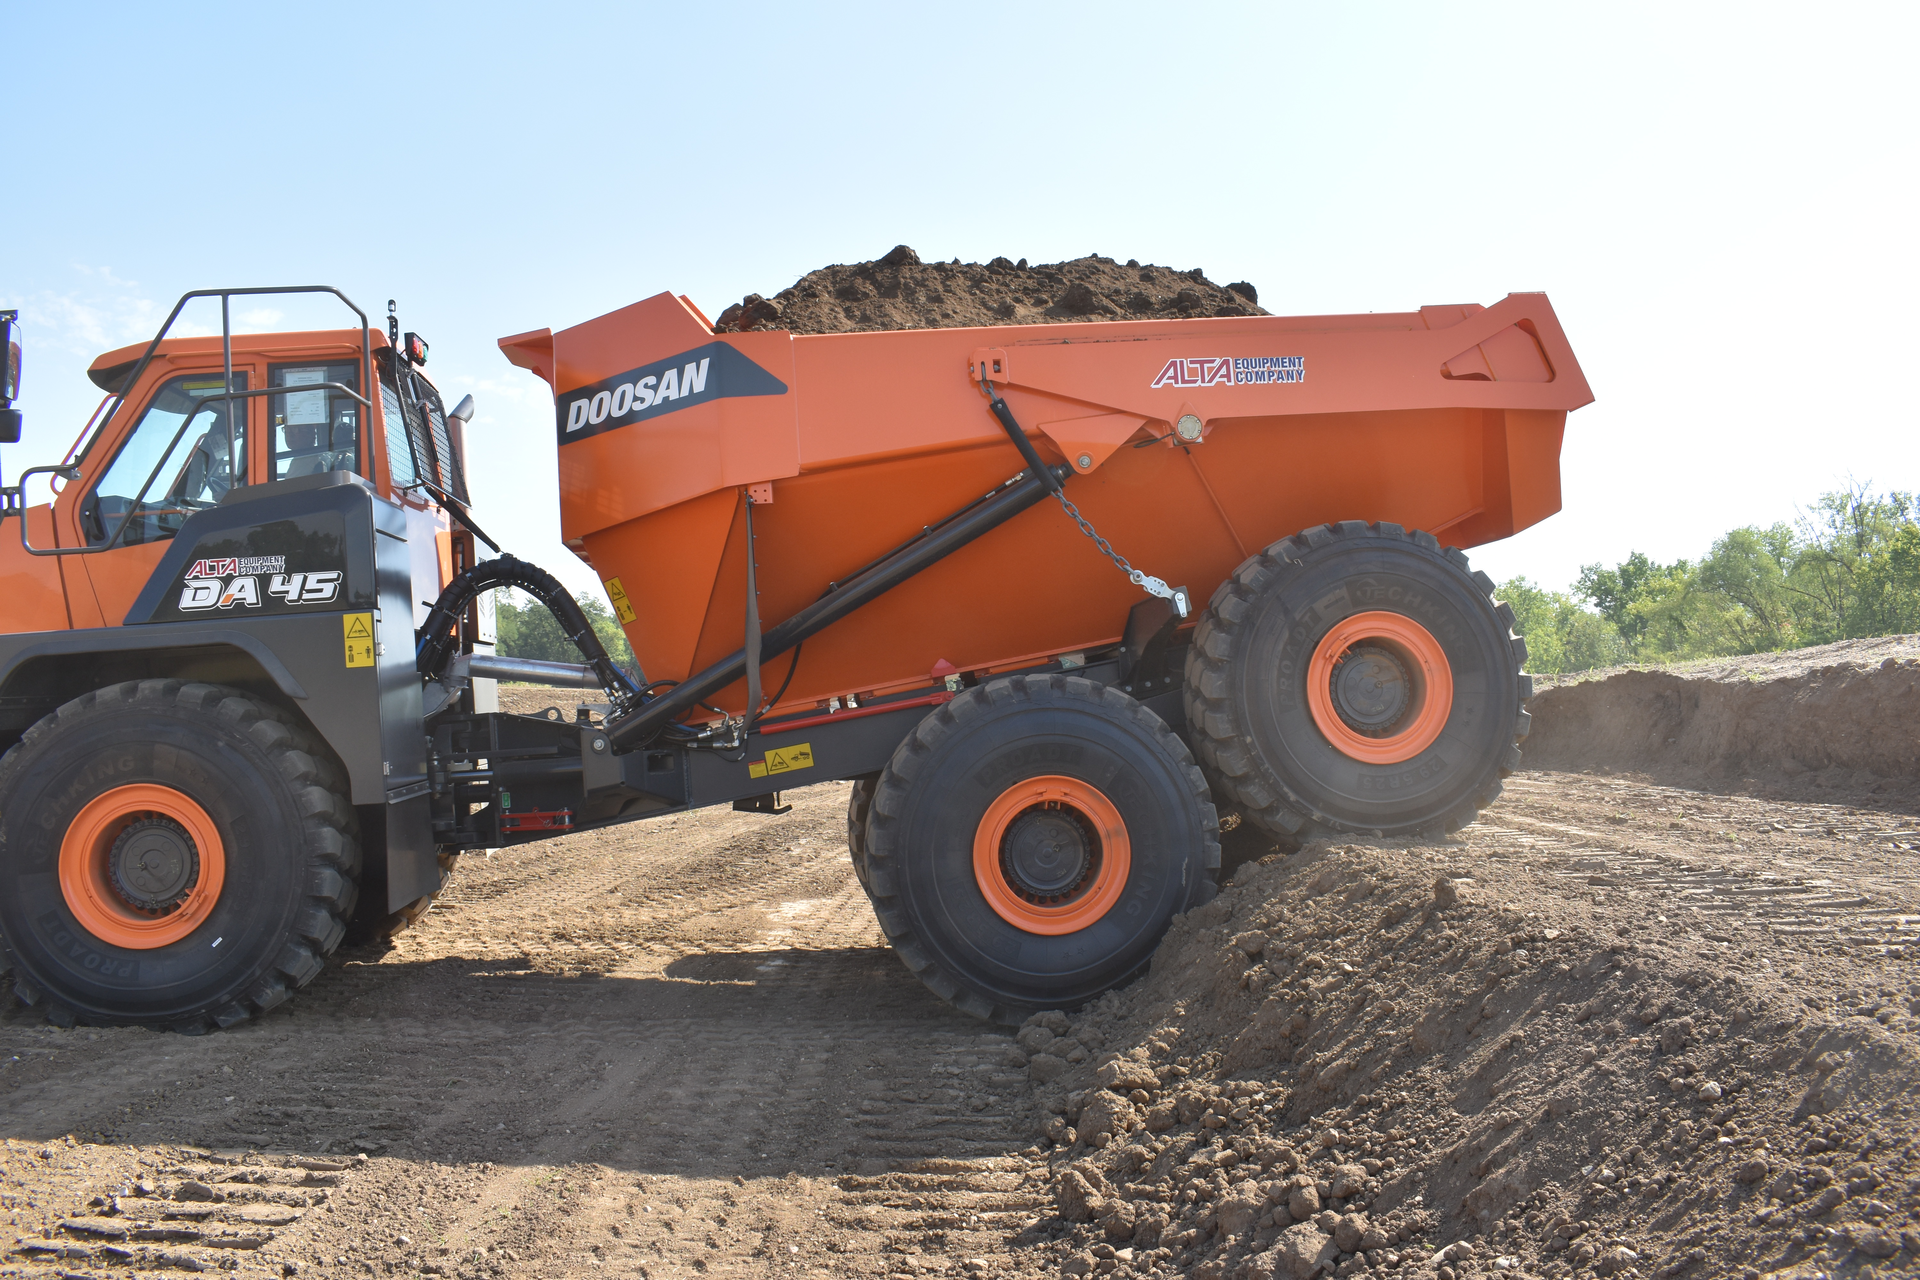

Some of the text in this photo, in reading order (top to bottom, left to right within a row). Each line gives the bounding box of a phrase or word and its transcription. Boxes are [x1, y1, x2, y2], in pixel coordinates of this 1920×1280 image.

[1150, 356, 1304, 388] ALTA EQUIPMENT
[1235, 369, 1305, 385] COMPANY
[566, 358, 710, 433] DOOSAN
[184, 556, 285, 579] ALTA EQUIPMENT
[239, 564, 285, 575] COMPANY
[179, 570, 343, 612] DA 45
[1280, 613, 1317, 706] PROADT
[43, 919, 135, 979] PROADT
